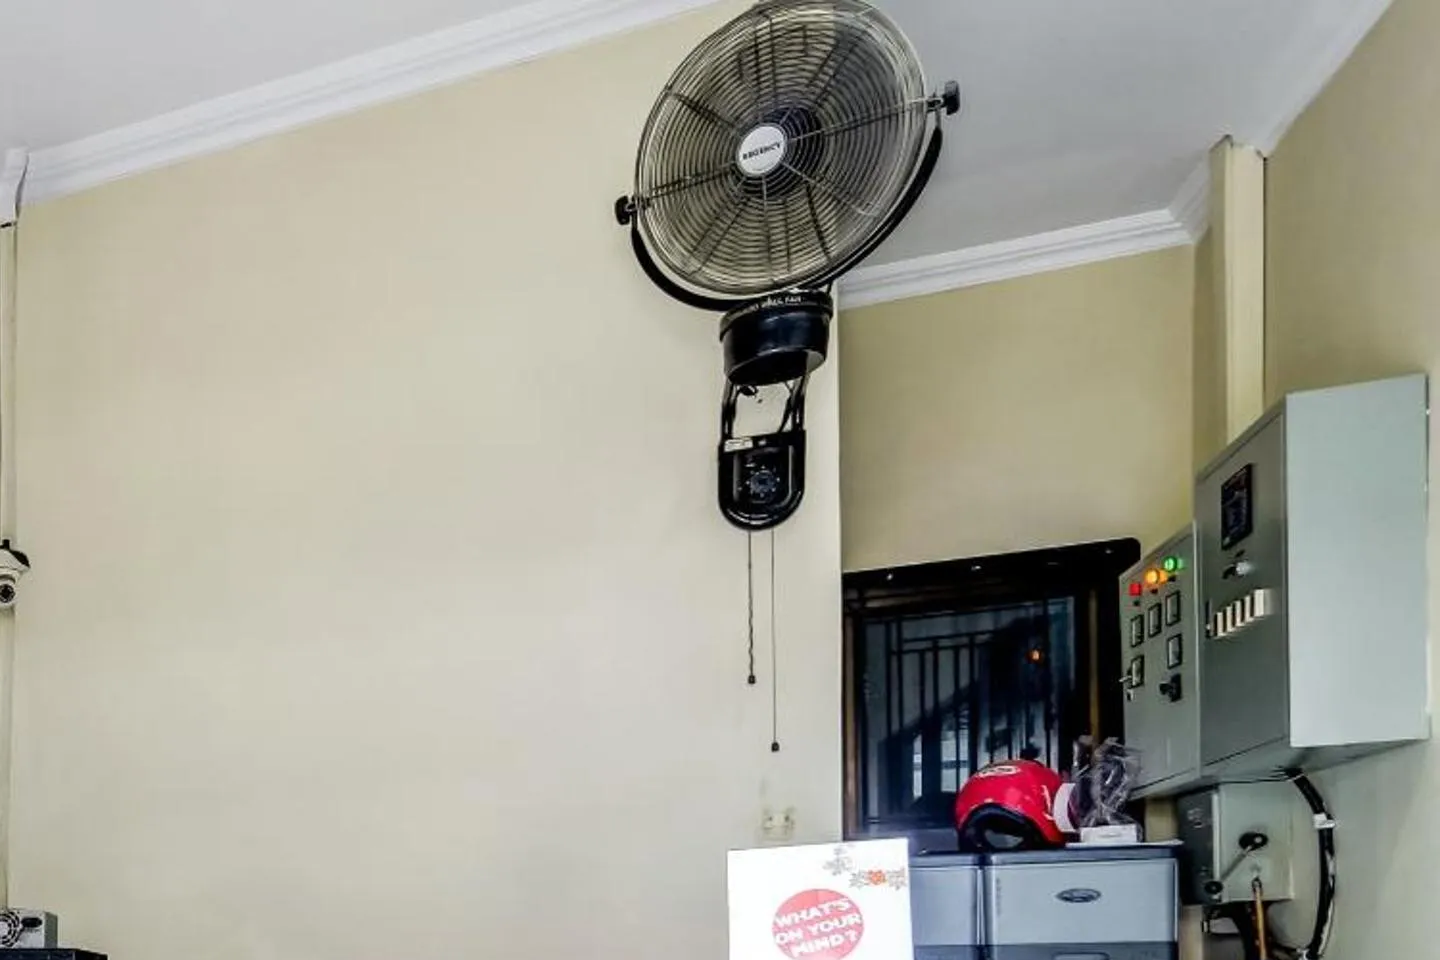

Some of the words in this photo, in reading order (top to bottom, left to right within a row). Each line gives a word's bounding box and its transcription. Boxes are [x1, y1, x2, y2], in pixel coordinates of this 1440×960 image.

[776, 898, 850, 926] WHAT'S
[775, 928, 803, 945] ON
[807, 913, 862, 935] YOUR
